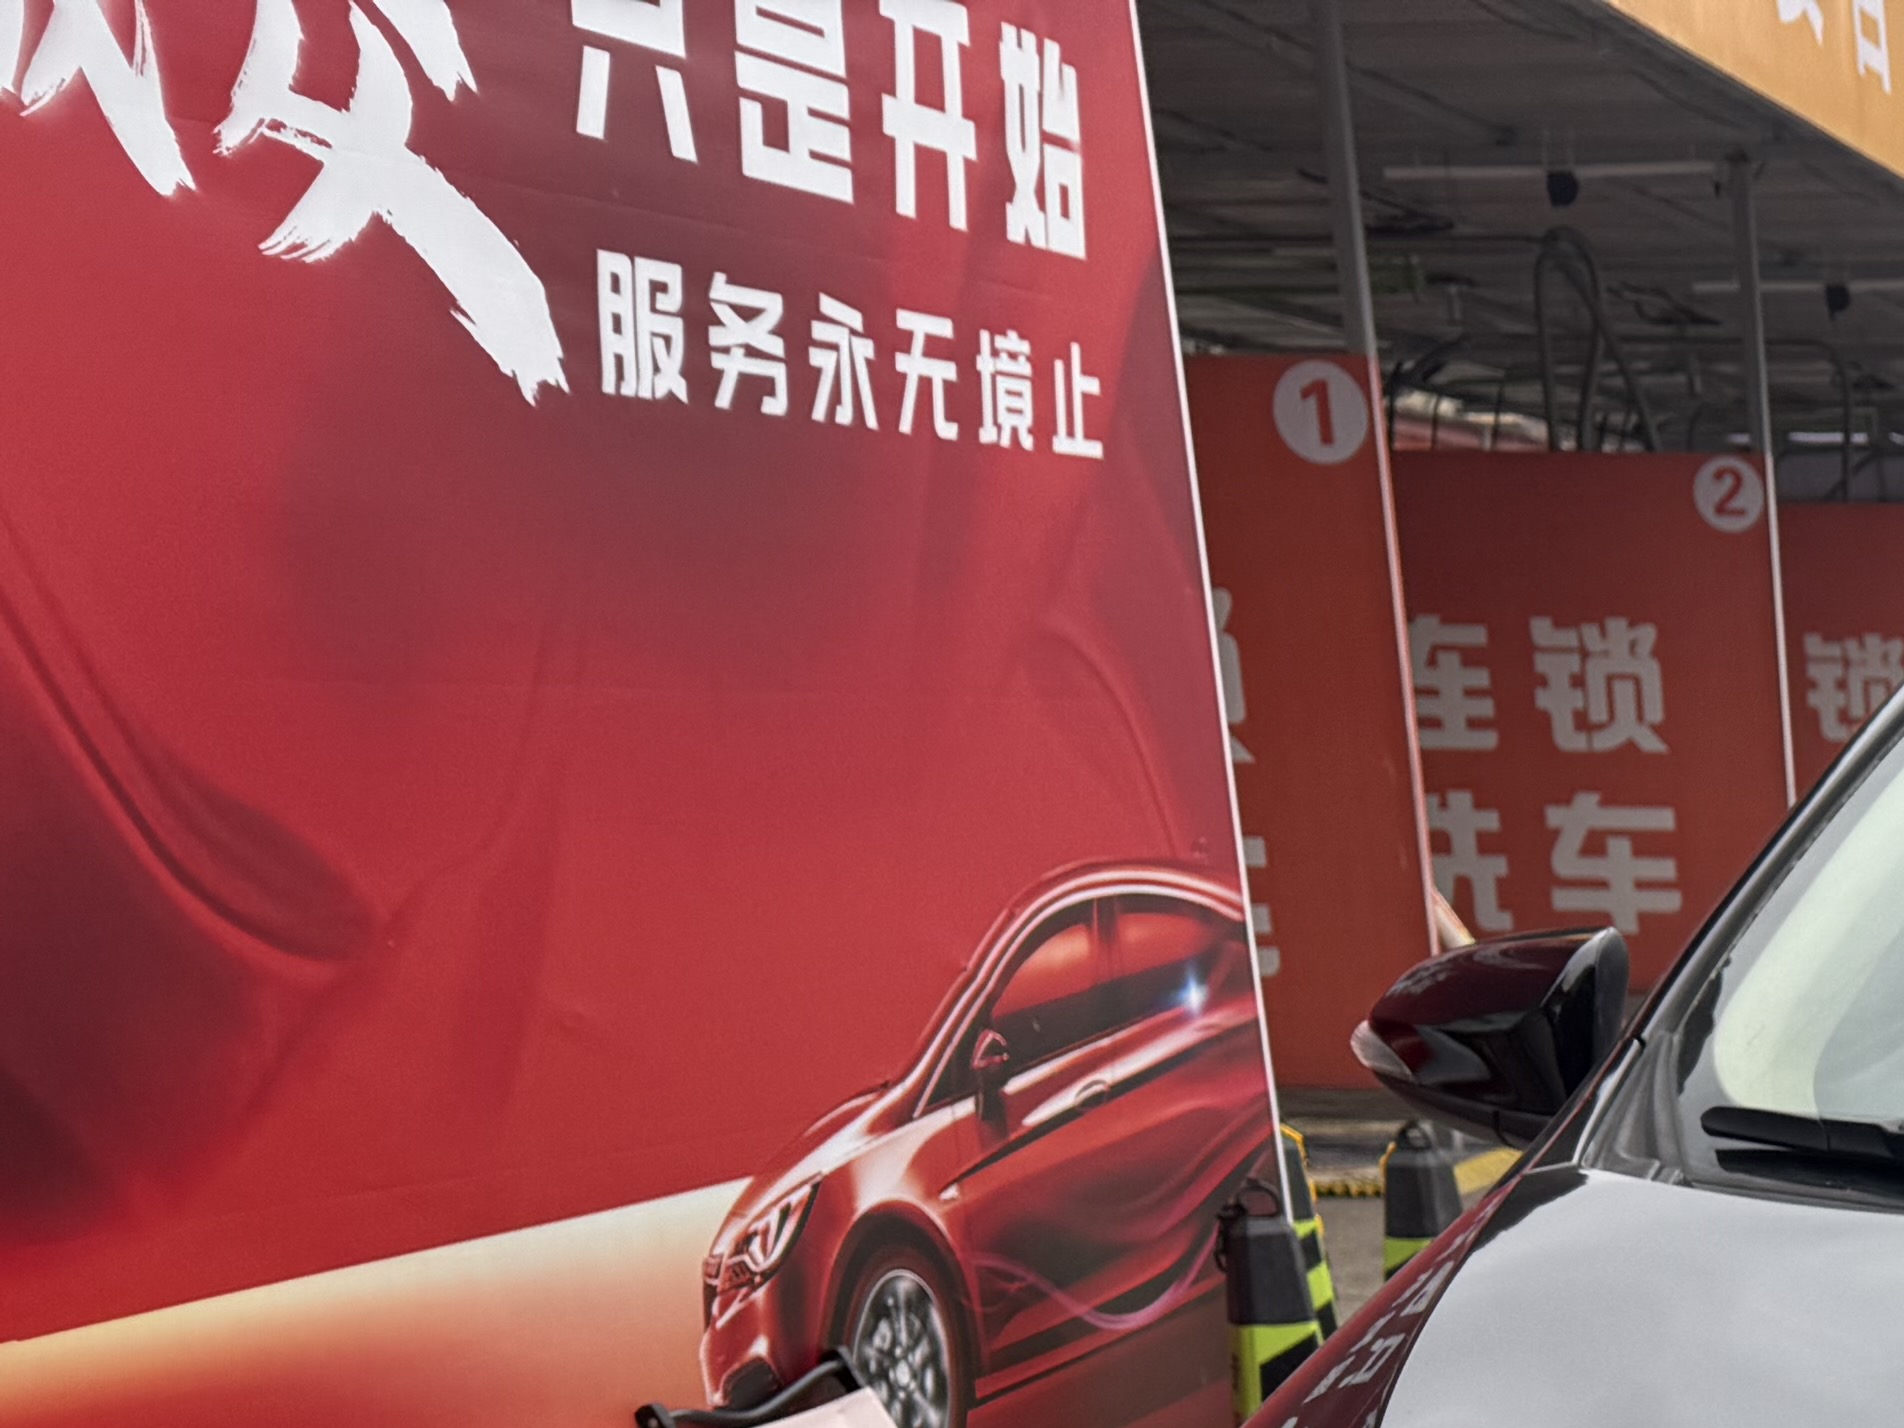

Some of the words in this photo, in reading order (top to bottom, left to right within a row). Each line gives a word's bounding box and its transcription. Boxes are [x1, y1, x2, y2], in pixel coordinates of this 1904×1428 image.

[571, 0, 1087, 260] 只是开始
[597, 247, 1105, 460] 服务永无境止
